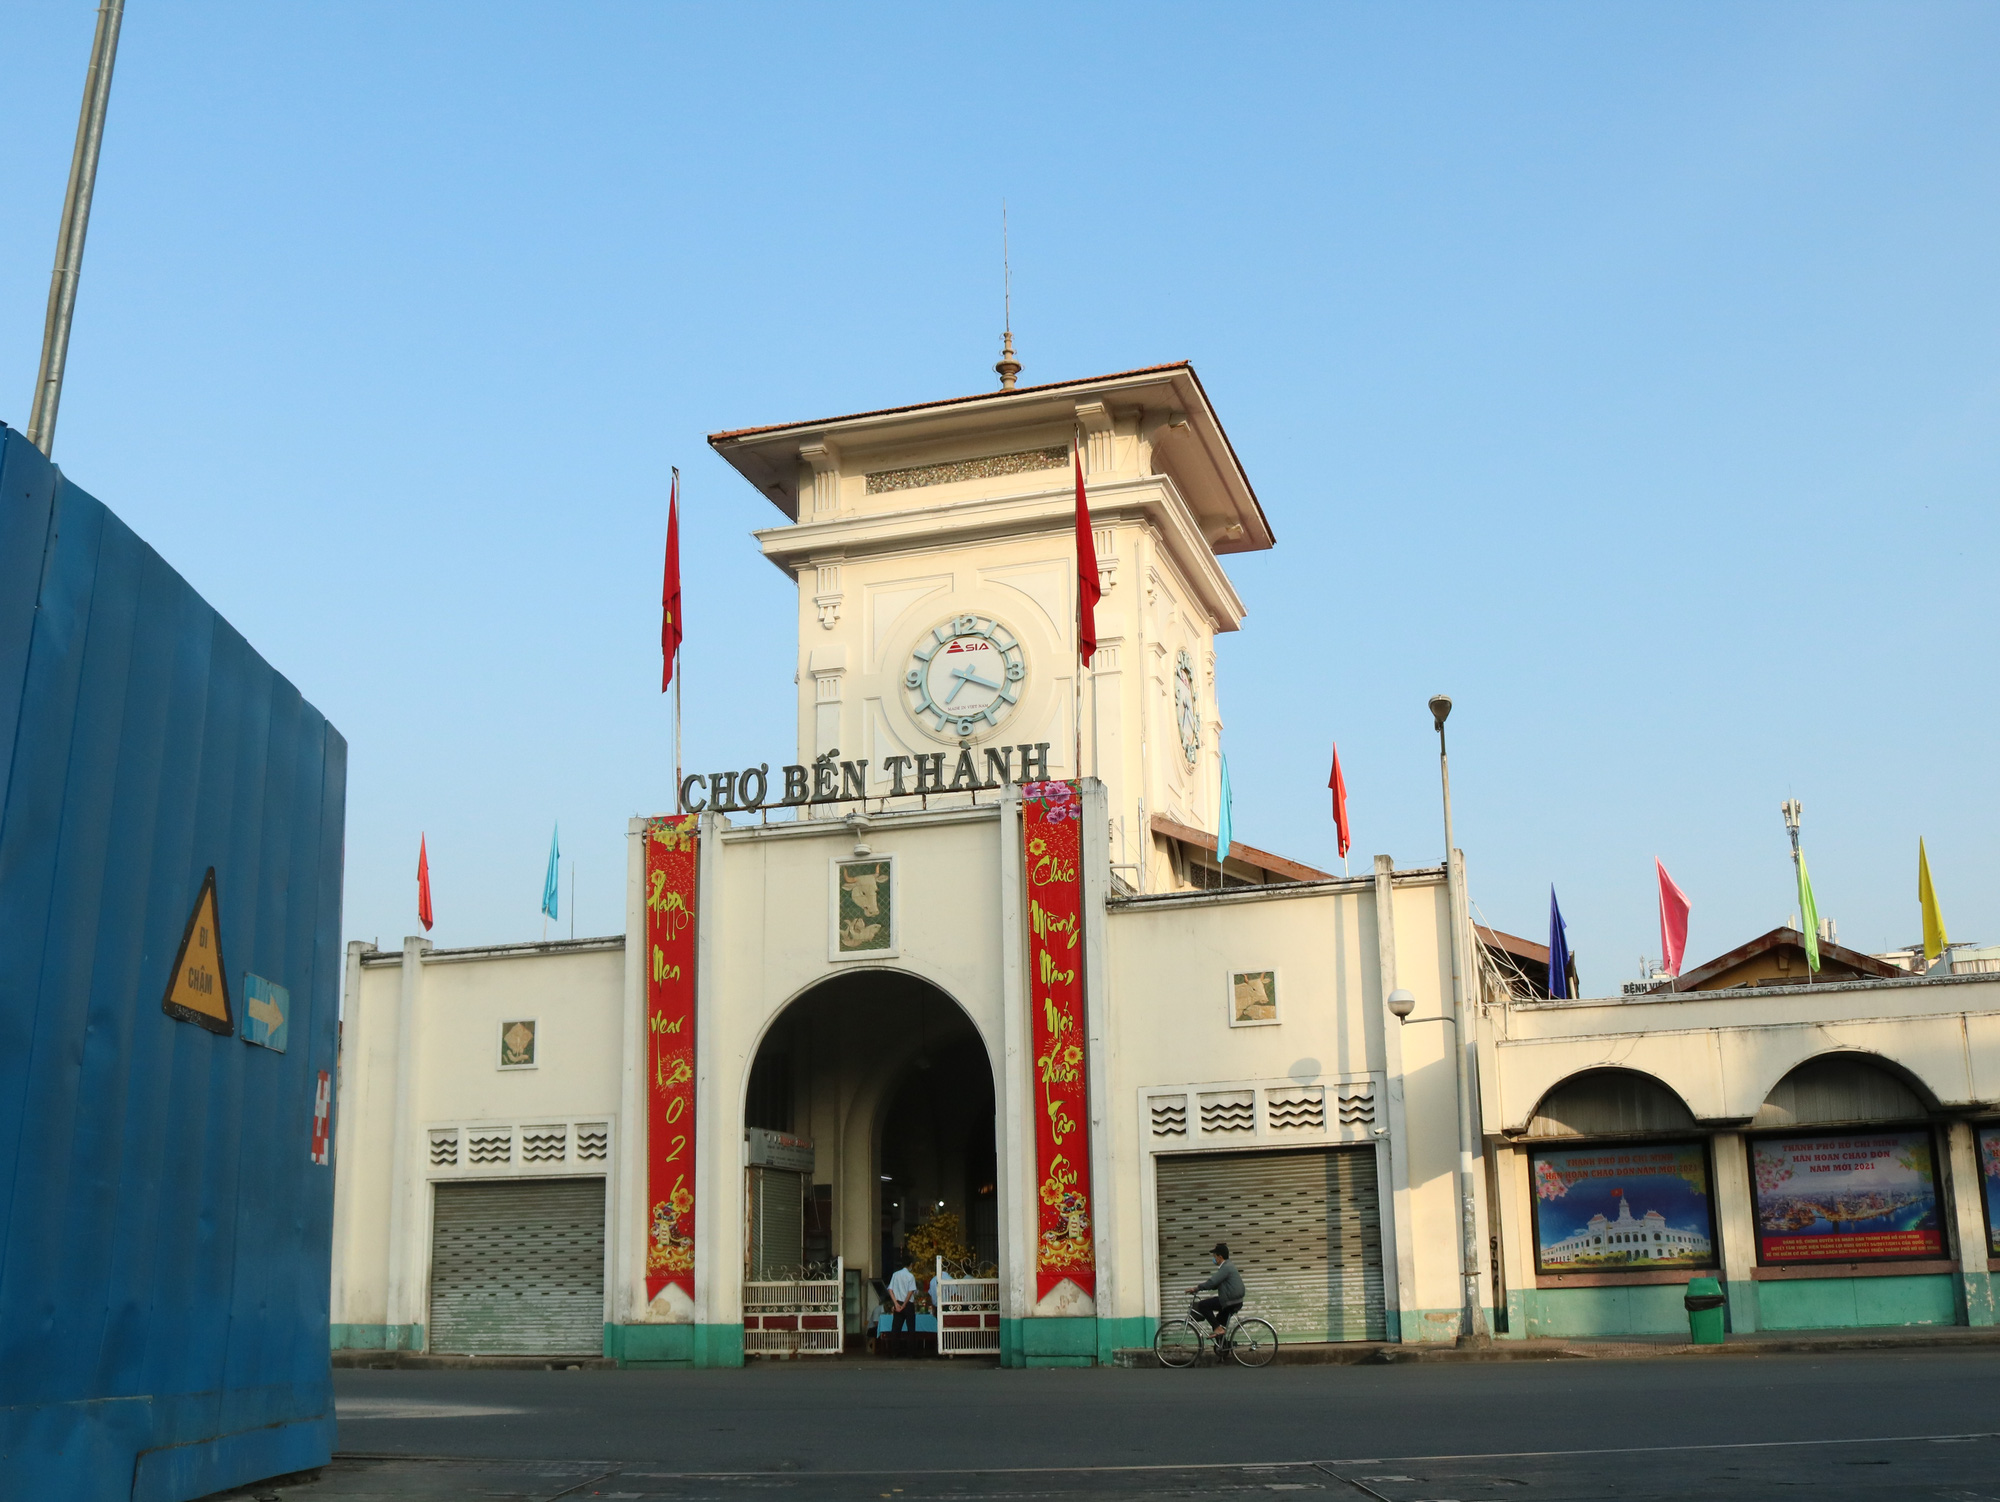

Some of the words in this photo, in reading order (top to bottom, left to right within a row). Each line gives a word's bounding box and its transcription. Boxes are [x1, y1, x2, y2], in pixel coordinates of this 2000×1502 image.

[952, 616, 978, 636] 12
[906, 670, 922, 688] 9
[1006, 661, 1024, 682] 3
[956, 716, 974, 736] 6
[681, 762, 769, 814] CHỢ
[782, 748, 869, 805] BẾN
[883, 740, 1051, 797] THÀNH
[1033, 855, 1077, 886] Chúc
[646, 869, 695, 941] Happy
[199, 926, 209, 949] ĐI
[188, 965, 213, 997] CHẬM
[1623, 981, 1648, 995] BỆNH
[1854, 1162, 1876, 1170] 2021
